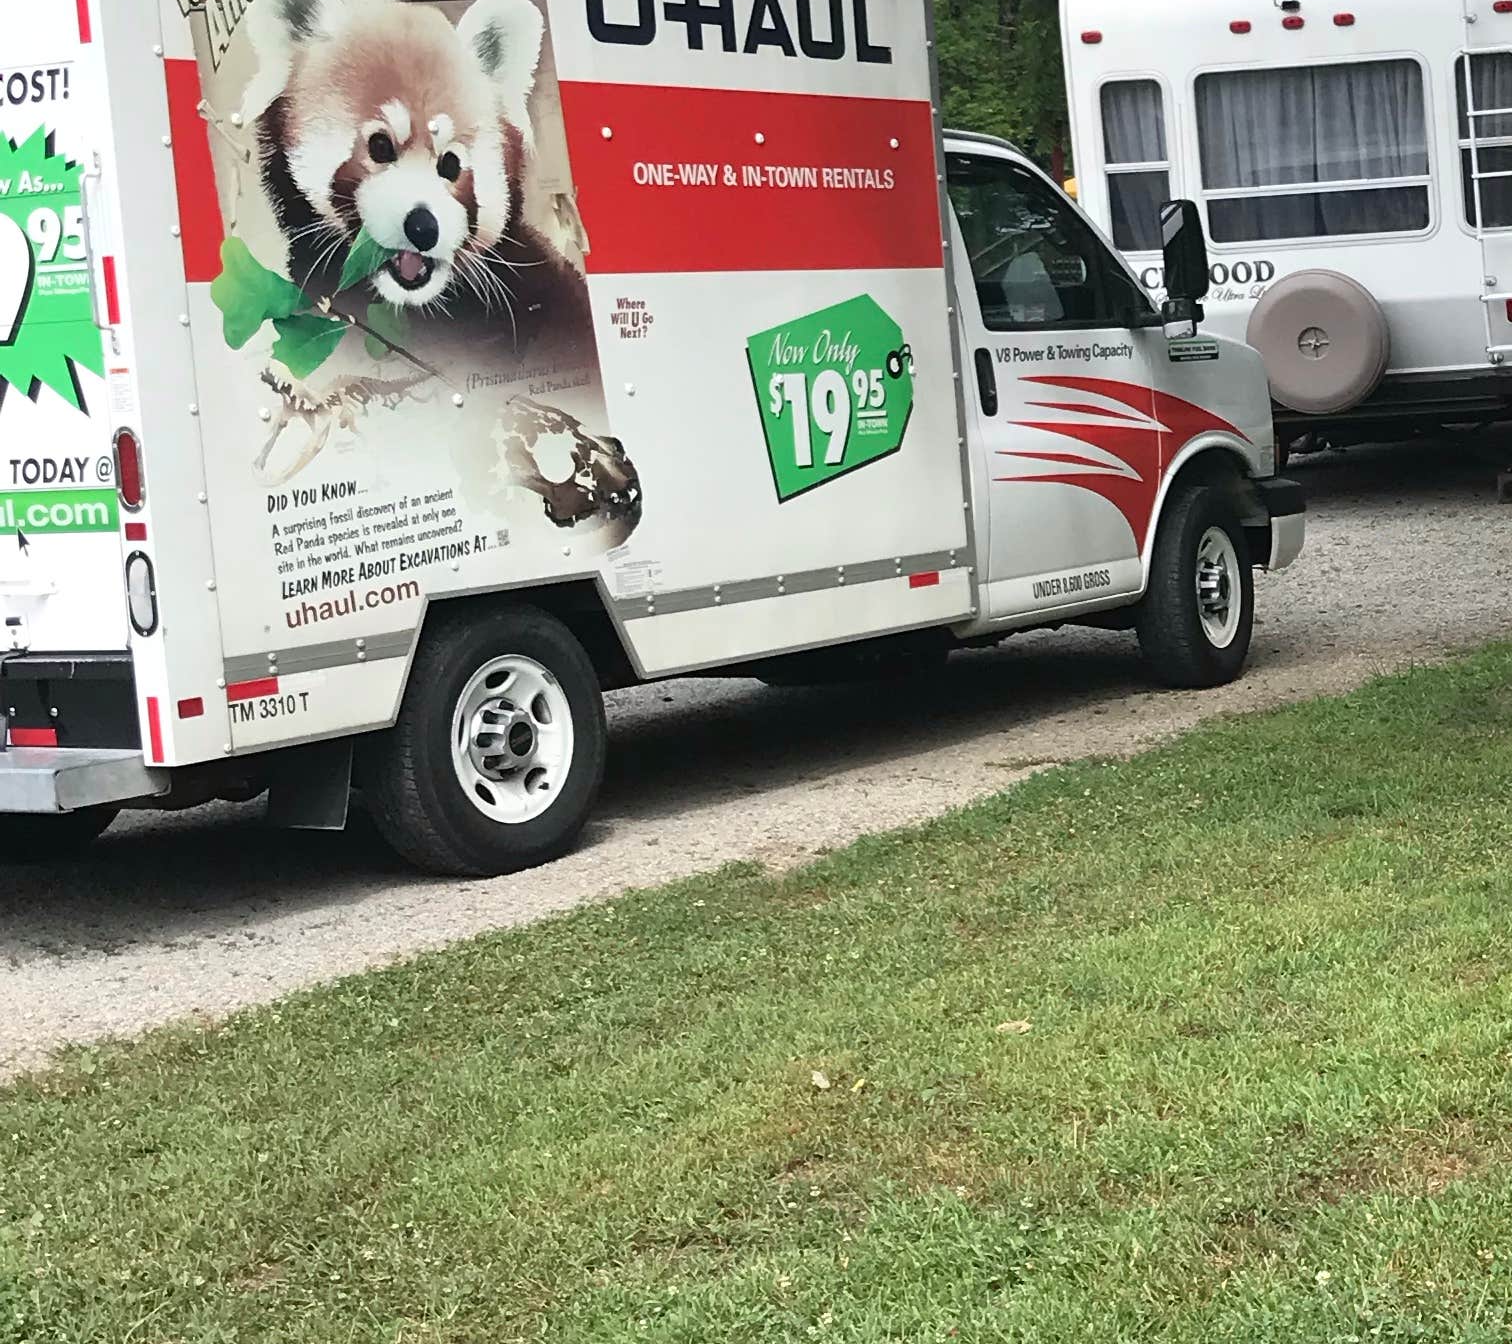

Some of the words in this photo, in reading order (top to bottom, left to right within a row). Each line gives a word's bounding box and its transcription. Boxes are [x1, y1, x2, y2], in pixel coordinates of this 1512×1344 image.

[0, 67, 69, 105] OST!
[633, 162, 718, 187] ONE-WAY
[723, 165, 738, 187] &
[742, 166, 818, 189] IN-TOWN
[822, 168, 895, 190] RENTALS
[37, 272, 90, 289] IN-TOW
[616, 297, 646, 310] Where
[611, 312, 629, 325] Will
[631, 311, 640, 328] U
[642, 312, 654, 324] Go
[620, 325, 648, 339] Next?
[768, 332, 809, 367] Now
[812, 329, 861, 375] Only
[995, 347, 1012, 363] V8
[1013, 347, 1045, 362] Power
[1046, 345, 1056, 360] &
[1056, 344, 1091, 362] Towing
[1092, 342, 1134, 361] Capacity
[10, 457, 90, 485] TODAY
[96, 456, 113, 483] @
[272, 523, 280, 539] A
[283, 516, 328, 537] surprising
[329, 508, 354, 526] fossil
[356, 502, 396, 519] discovery
[399, 496, 408, 509] of
[410, 496, 422, 508] an
[424, 488, 454, 503] ancient
[275, 539, 294, 556] Red
[297, 533, 326, 551] Panda
[328, 528, 360, 546] species
[363, 524, 371, 537] is
[373, 516, 409, 534] revealed
[412, 513, 420, 526] at
[422, 508, 440, 524] only
[441, 506, 457, 518] one
[277, 559, 295, 575] site
[297, 557, 306, 570] in
[307, 553, 323, 567] the
[324, 546, 352, 562] world.
[354, 541, 380, 556] What
[381, 534, 416, 551] remains
[417, 519, 463, 542] uncovered?
[1032, 578, 1062, 600] UNDER
[1062, 575, 1083, 595] 8,600
[1083, 569, 1111, 590] GROSS
[286, 579, 420, 629] uhaul.com
[228, 701, 255, 723] TM
[259, 694, 297, 719] 3310
[299, 692, 309, 712] T
